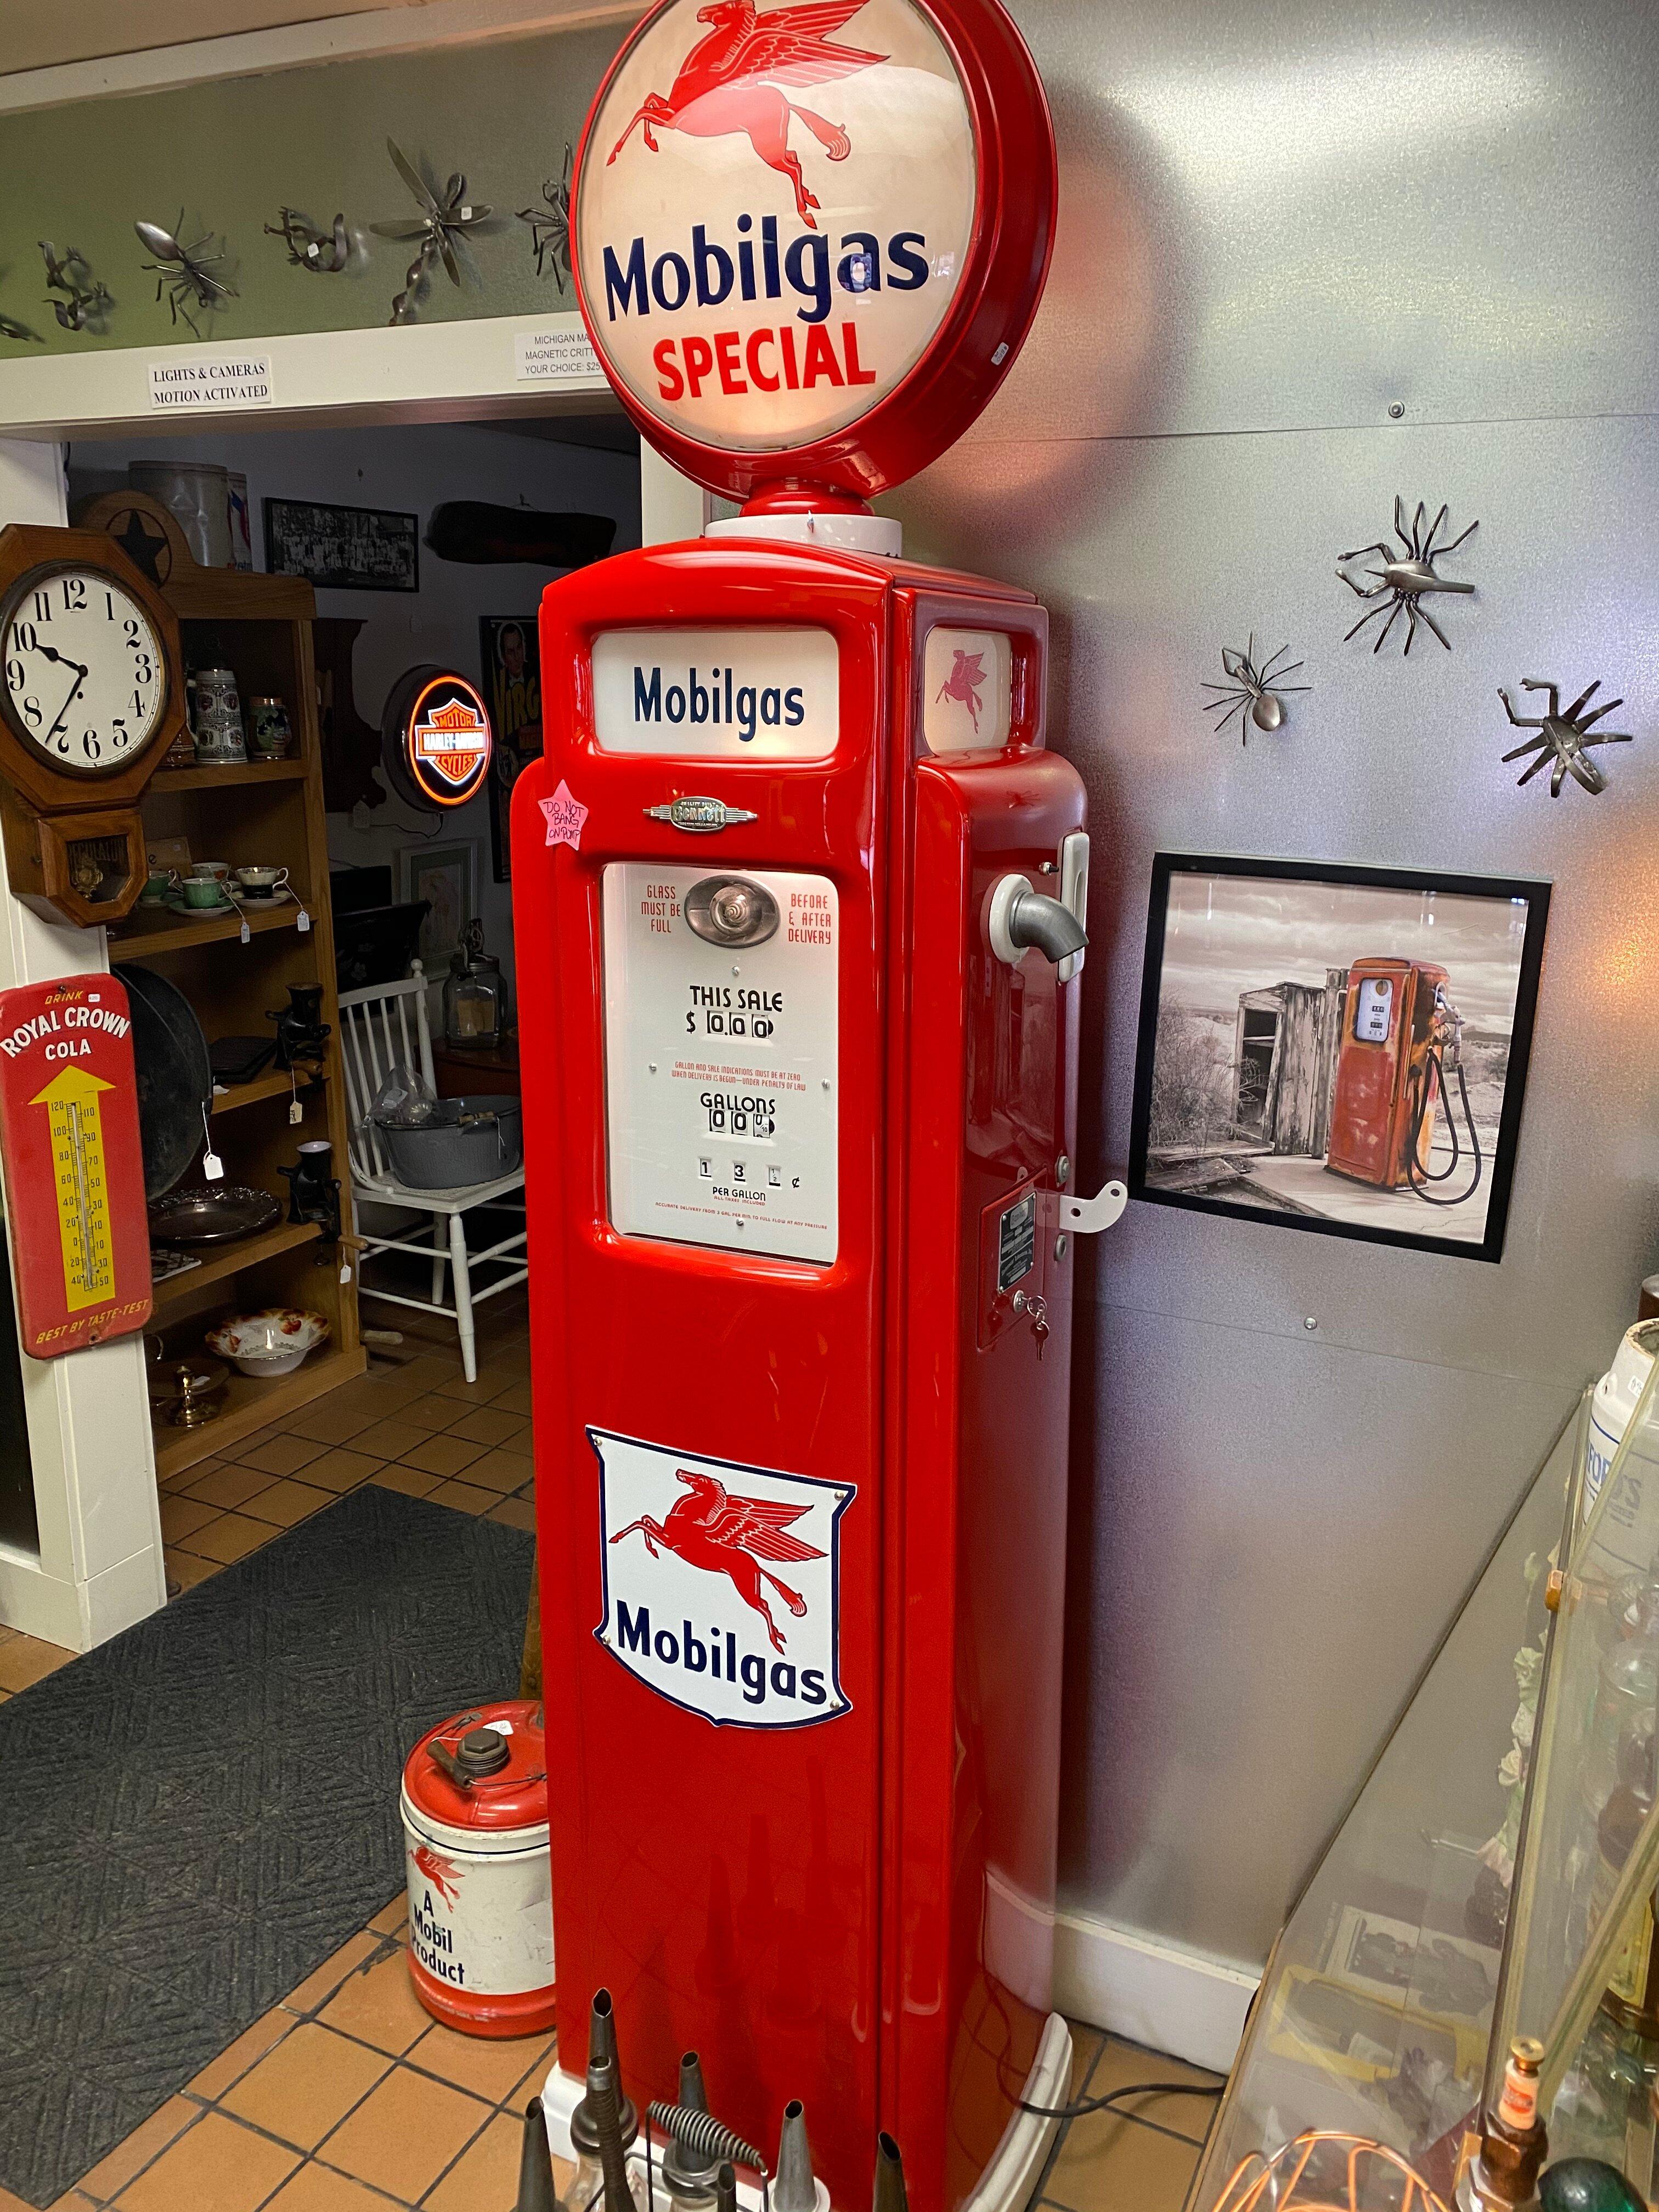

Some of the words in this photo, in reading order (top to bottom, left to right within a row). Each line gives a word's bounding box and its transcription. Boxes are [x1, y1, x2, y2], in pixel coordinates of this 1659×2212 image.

[603, 214, 929, 323] Mobilgas
[535, 334, 575, 345] MICHIGAN
[526, 348, 568, 360] MAGNETIC
[653, 322, 876, 401] SPECIAL
[154, 369, 195, 382] LIGHTS
[199, 368, 206, 379] &
[210, 363, 265, 378] CAMERAS
[525, 365, 548, 374] YOUR
[550, 363, 584, 373] CHOICE:
[154, 390, 200, 403] MOTION
[204, 385, 267, 400] ACTIVATED
[61, 579, 87, 610] 12
[35, 592, 52, 621] 11
[105, 592, 115, 620] 1
[13, 622, 36, 651] 10
[123, 619, 140, 649] 2
[7, 659, 25, 691] 9
[135, 653, 151, 683] 3
[24, 696, 42, 726] 8
[128, 690, 145, 718] 4
[633, 667, 805, 742] Mobilgas
[439, 709, 472, 727] MOTOR
[54, 724, 69, 753] 7
[112, 719, 128, 747] 5
[83, 730, 100, 759] 6
[441, 754, 473, 775] CYCLES
[543, 802, 560, 813] DO
[565, 800, 584, 817] NOT
[552, 812, 579, 828] BANG
[549, 827, 560, 838] ON
[647, 885, 676, 899] GLASS
[791, 893, 828, 909] BEFORE
[641, 902, 665, 916] MUST
[670, 904, 681, 917] BE
[651, 919, 672, 933] FULL
[802, 912, 831, 927] AFTER
[788, 928, 831, 944] DELIVERY
[44, 991, 83, 1005] DRINK
[690, 985, 731, 1008] THIS
[737, 989, 783, 1012] SALE
[686, 1011, 696, 1034] $
[0, 1011, 61, 1058] ROYAL
[65, 1007, 130, 1039] CROWN
[45, 1039, 92, 1060] COLA
[672, 1070, 687, 1078] WHEN
[688, 1072, 712, 1081] DELIVERY
[761, 1080, 785, 1089] PENALTY
[675, 1062, 694, 1070] GALLON
[721, 1066, 753, 1076] INDICATIONS
[755, 1069, 769, 1077] MUST
[787, 1073, 800, 1081] ZERO
[51, 1101, 64, 1111] 120
[83, 1107, 94, 1118] 110
[700, 1092, 775, 1115] GALLONS
[54, 1126, 66, 1137] 100
[86, 1132, 95, 1142] 90
[59, 1150, 69, 1161] 80
[88, 1155, 98, 1166] 70
[61, 1174, 71, 1184] 60
[91, 1177, 100, 1188] 50
[702, 1162, 708, 1173] 1
[735, 1165, 744, 1177] 3
[792, 1177, 800, 1189] ¢
[63, 1197, 74, 1206] 40
[713, 1187, 729, 1196] PER
[732, 1189, 766, 1201] GALLON
[93, 1199, 102, 1210] 30
[66, 1218, 76, 1228] 20
[94, 1220, 102, 1230] 10
[73, 1237, 77, 1246] 0
[97, 1240, 104, 1249] 10
[70, 1257, 79, 1267] 20
[98, 1258, 107, 1268] 30
[100, 1276, 108, 1286] 50
[36, 1325, 67, 1344] BEST
[70, 1319, 84, 1333] BY
[88, 1299, 150, 1327] TASTE-TEST
[617, 1599, 827, 1704] Mobilgas
[424, 1889, 434, 1917] A
[414, 1903, 453, 1953] Mobil
[412, 1924, 465, 1984] Product
